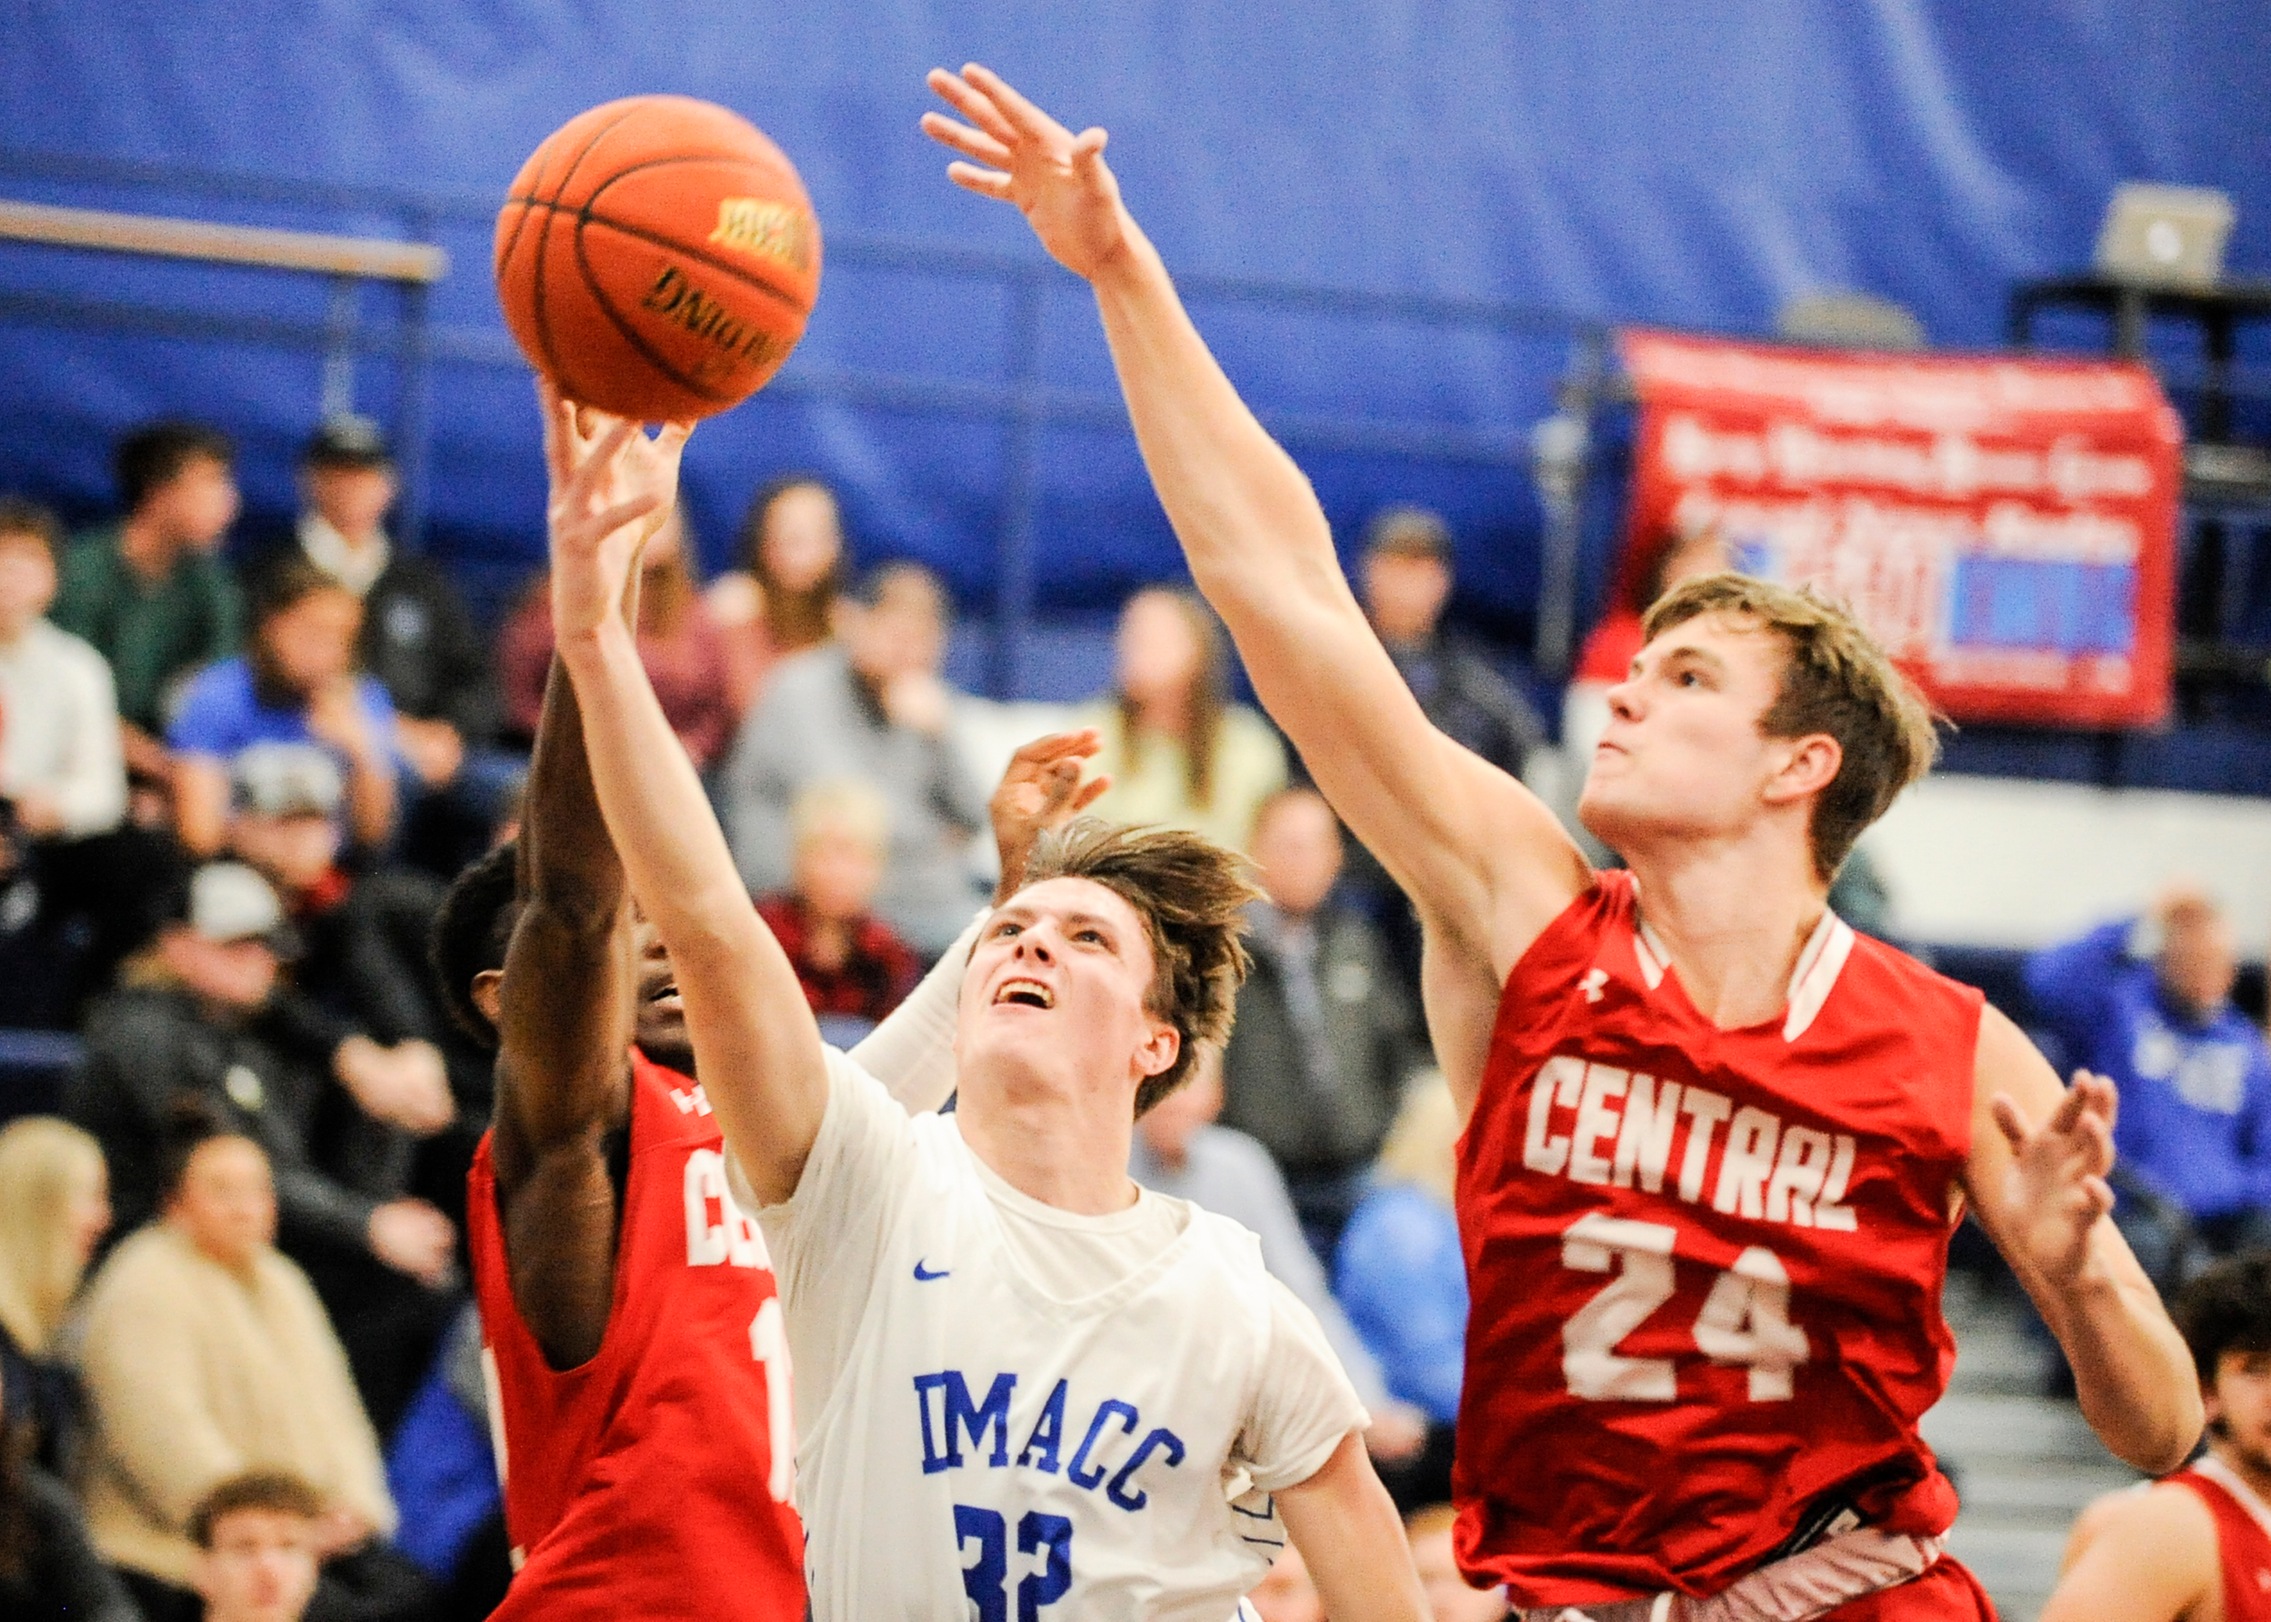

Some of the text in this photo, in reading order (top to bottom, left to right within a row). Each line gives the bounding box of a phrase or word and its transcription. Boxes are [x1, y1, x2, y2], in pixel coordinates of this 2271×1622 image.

[1522, 1054, 1859, 1232] CENTRAL
[1560, 1211, 1810, 1403] 24
[952, 1503, 1074, 1622] 32
